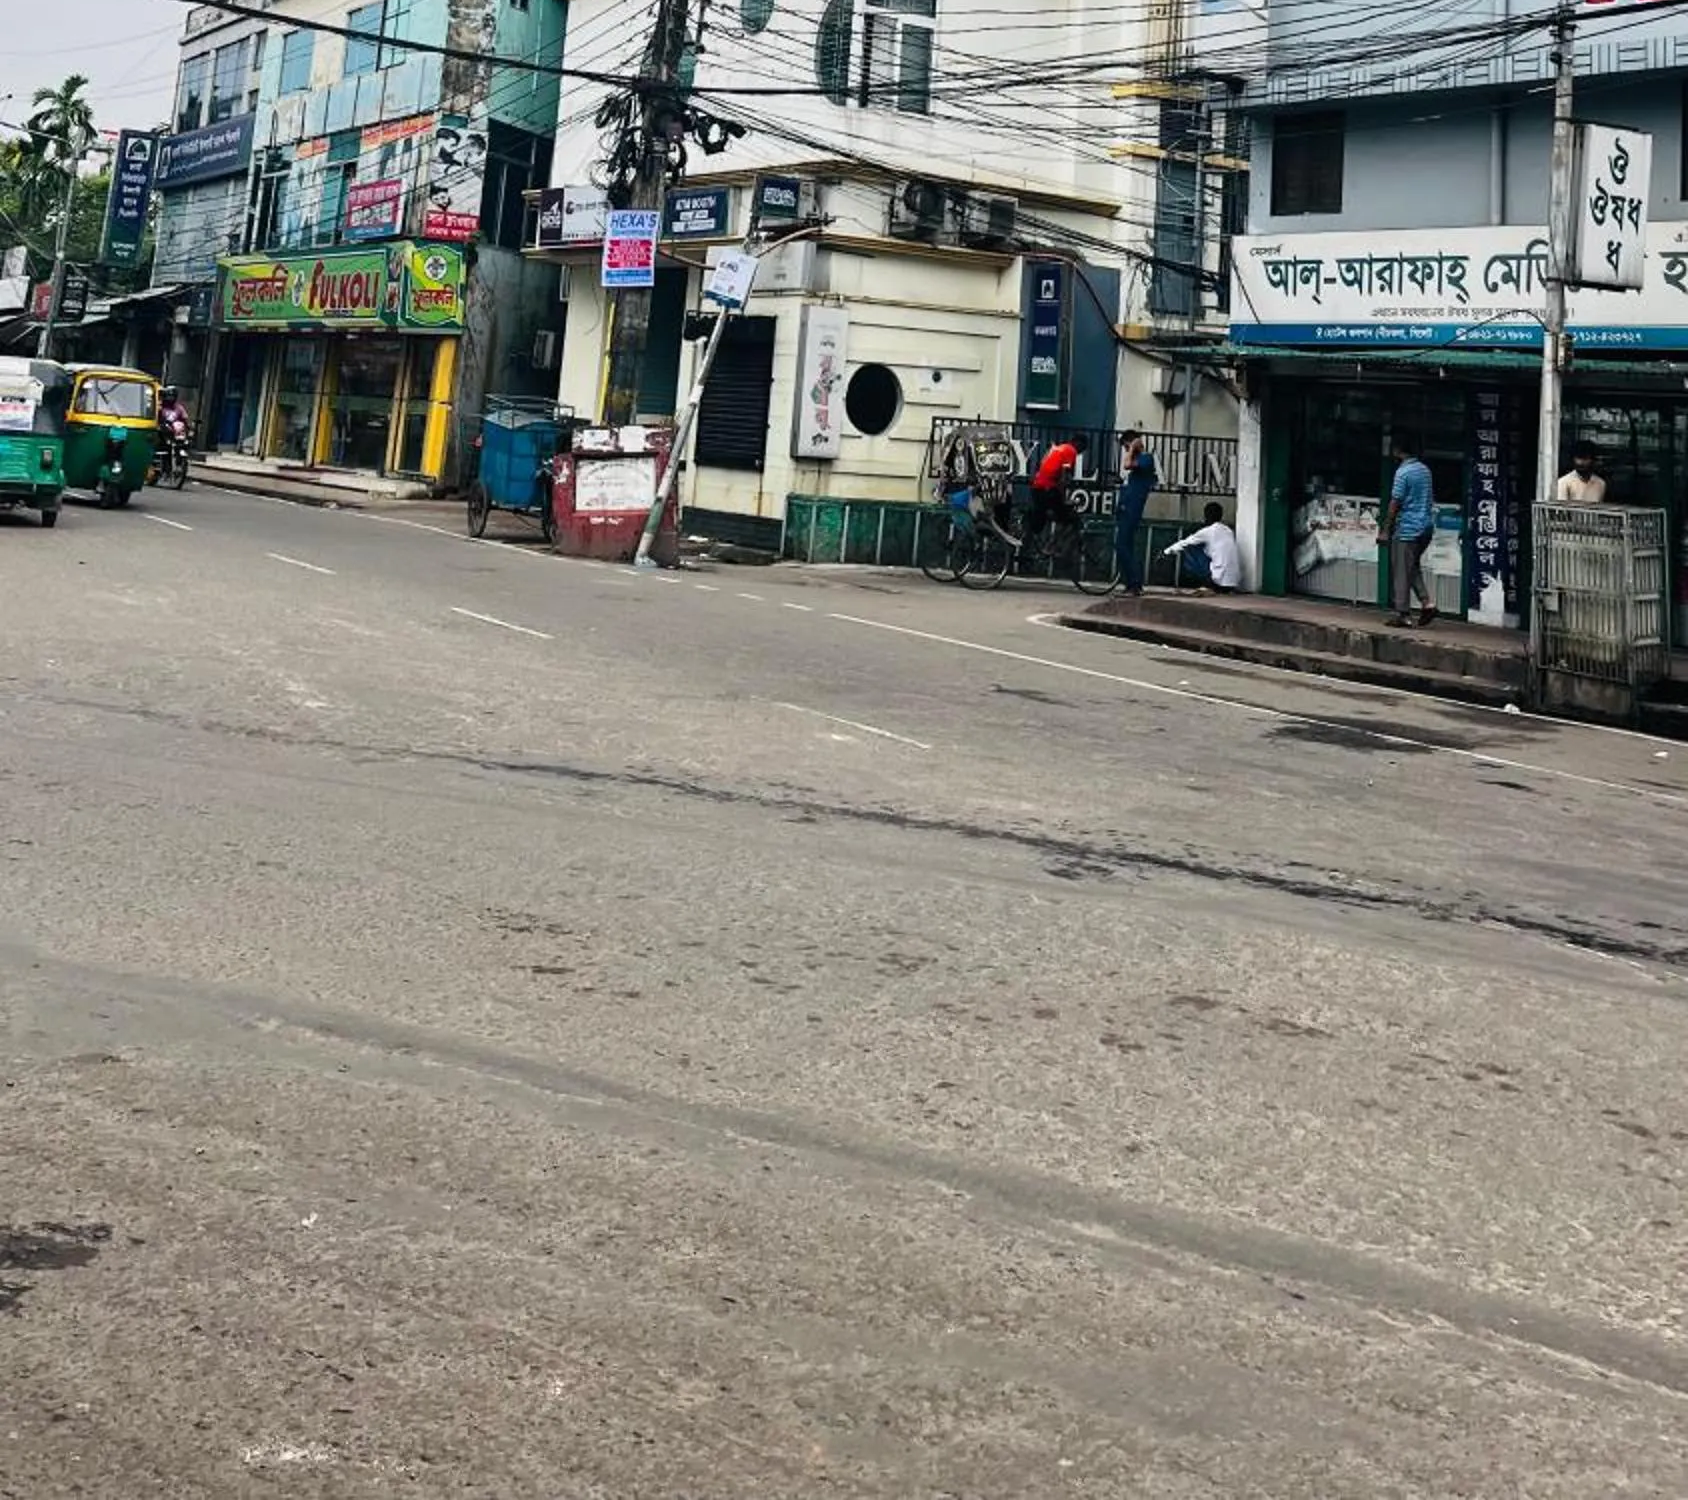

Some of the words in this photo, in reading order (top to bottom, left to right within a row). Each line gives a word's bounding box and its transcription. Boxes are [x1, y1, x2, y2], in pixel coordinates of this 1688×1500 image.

[611, 213, 657, 229] HEXA'S
[308, 260, 380, 310] FULKOLI
[1065, 487, 1120, 515] OTE
